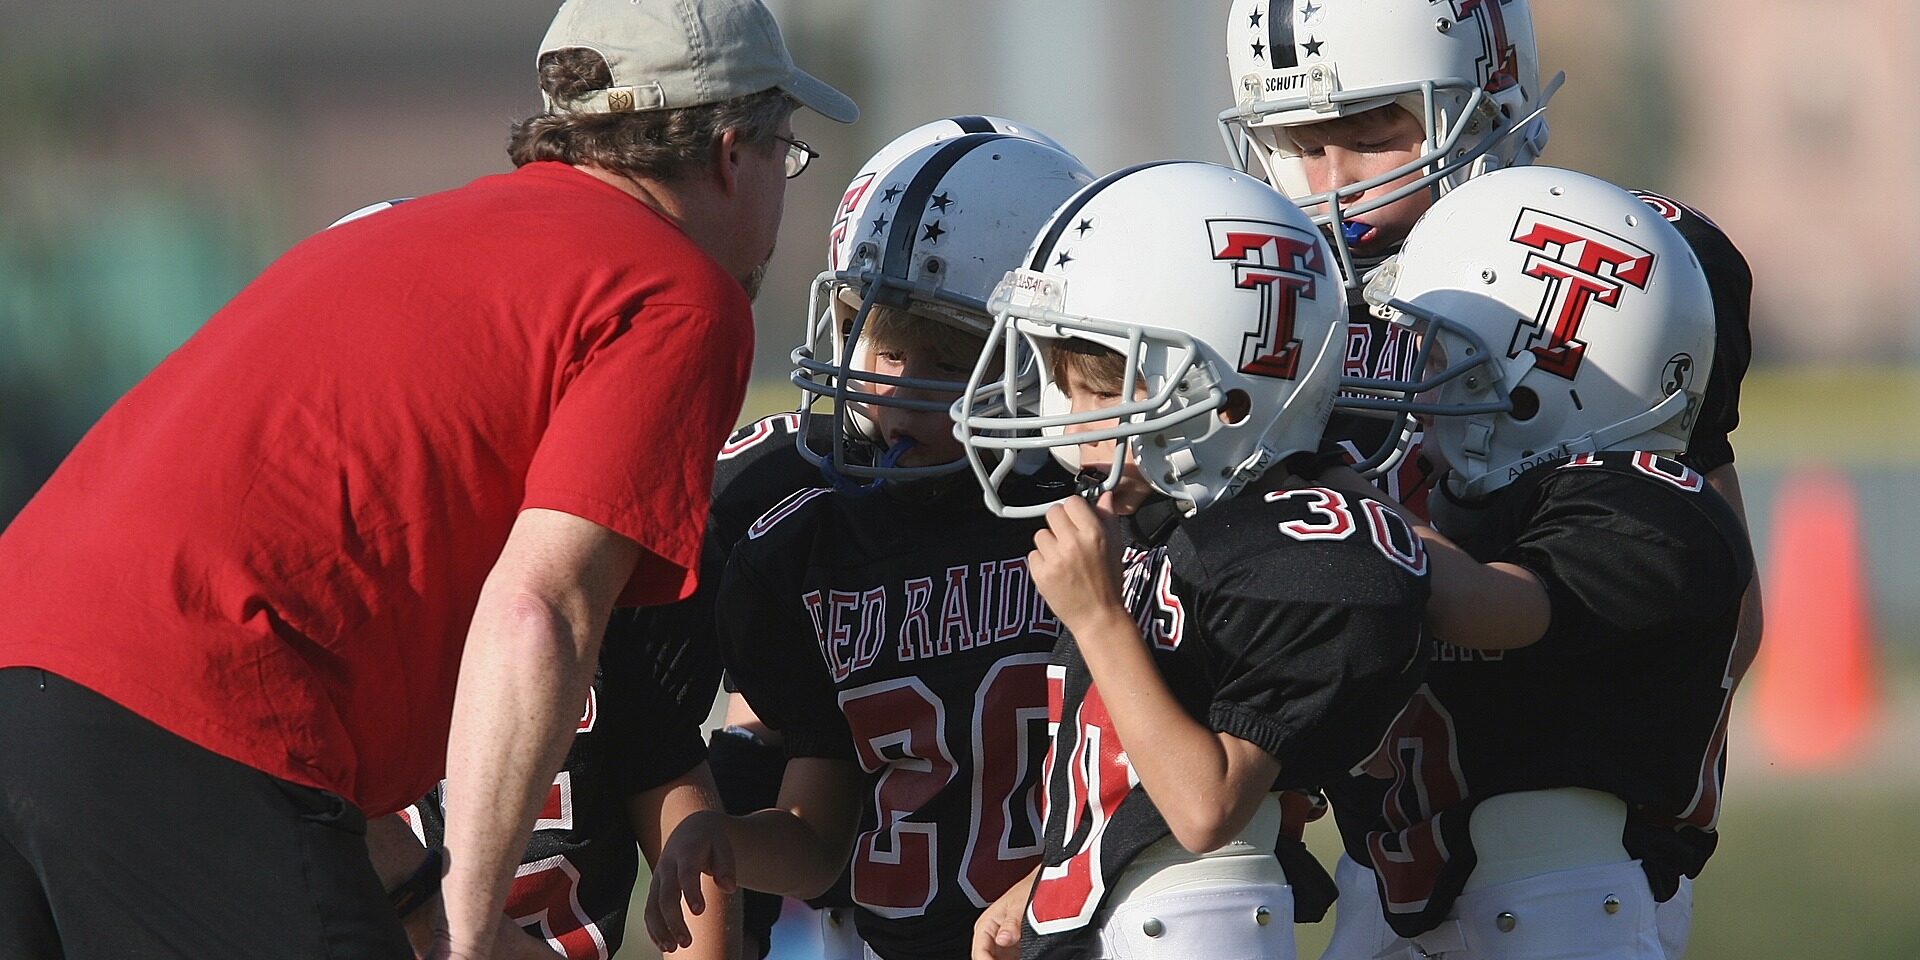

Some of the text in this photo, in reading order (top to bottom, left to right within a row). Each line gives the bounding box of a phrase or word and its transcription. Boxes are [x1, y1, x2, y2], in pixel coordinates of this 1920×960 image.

[1265, 73, 1307, 92] SCHUTT
[1264, 487, 1428, 576] 30
[838, 652, 1050, 919] 20
